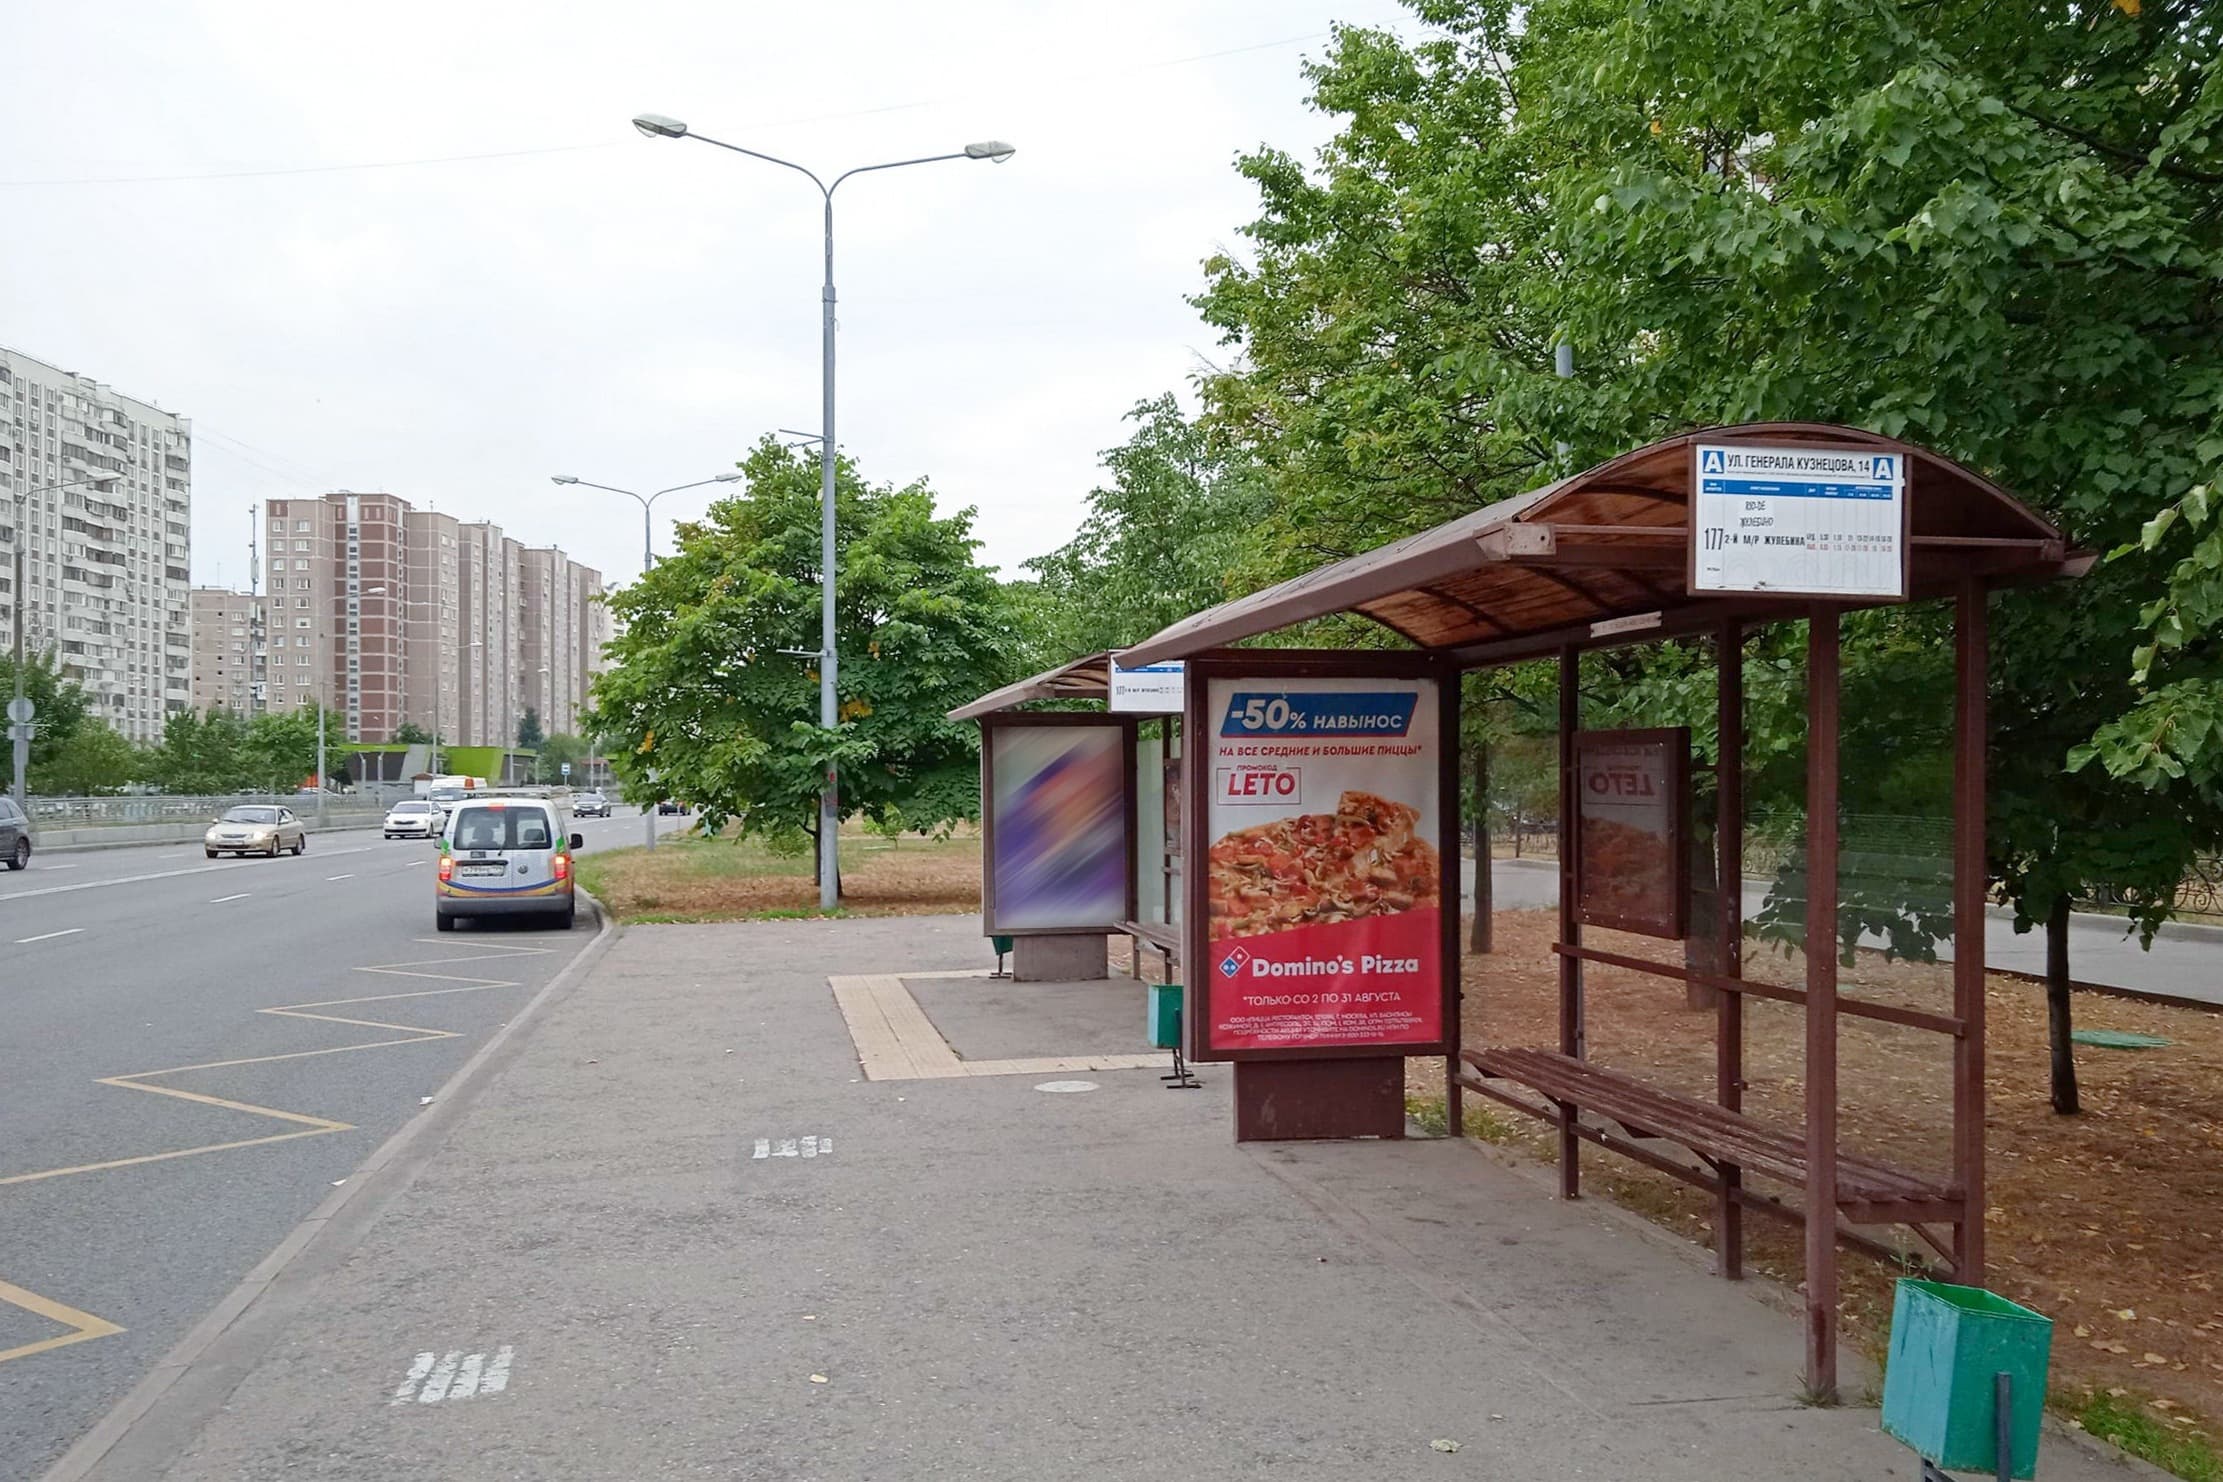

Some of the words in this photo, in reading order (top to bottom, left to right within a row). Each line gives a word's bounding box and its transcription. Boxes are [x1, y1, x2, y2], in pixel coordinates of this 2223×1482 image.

[1727, 454, 1743, 468] УЛ.
[1745, 455, 1795, 470] ГЕНЕРАЛА
[1796, 457, 1856, 473] КУЗНЕЦОВА,
[1858, 459, 1870, 472] 14
[1704, 528, 1724, 550] 177
[1743, 534, 1760, 546] М/Р
[1231, 698, 1307, 730] -50%
[1313, 714, 1403, 729] НАВЫНОС
[1219, 746, 1234, 756] НА
[1237, 746, 1259, 756] ВСЕ
[1260, 746, 1310, 758] СРЕДНИЕ
[1312, 746, 1321, 756] И
[1322, 745, 1376, 756] БОЛЬШИЕ
[1236, 764, 1278, 772] ПРОМОКОД
[1228, 772, 1296, 796] LETO
[1252, 954, 1355, 978] Domino's
[1361, 953, 1419, 975] Pizza
[1292, 994, 1310, 1005] СО
[1312, 993, 1319, 1004] 2
[1321, 993, 1339, 1004] ПО
[1341, 993, 1352, 1004] 31
[1355, 991, 1401, 1003] АВГУСТА
